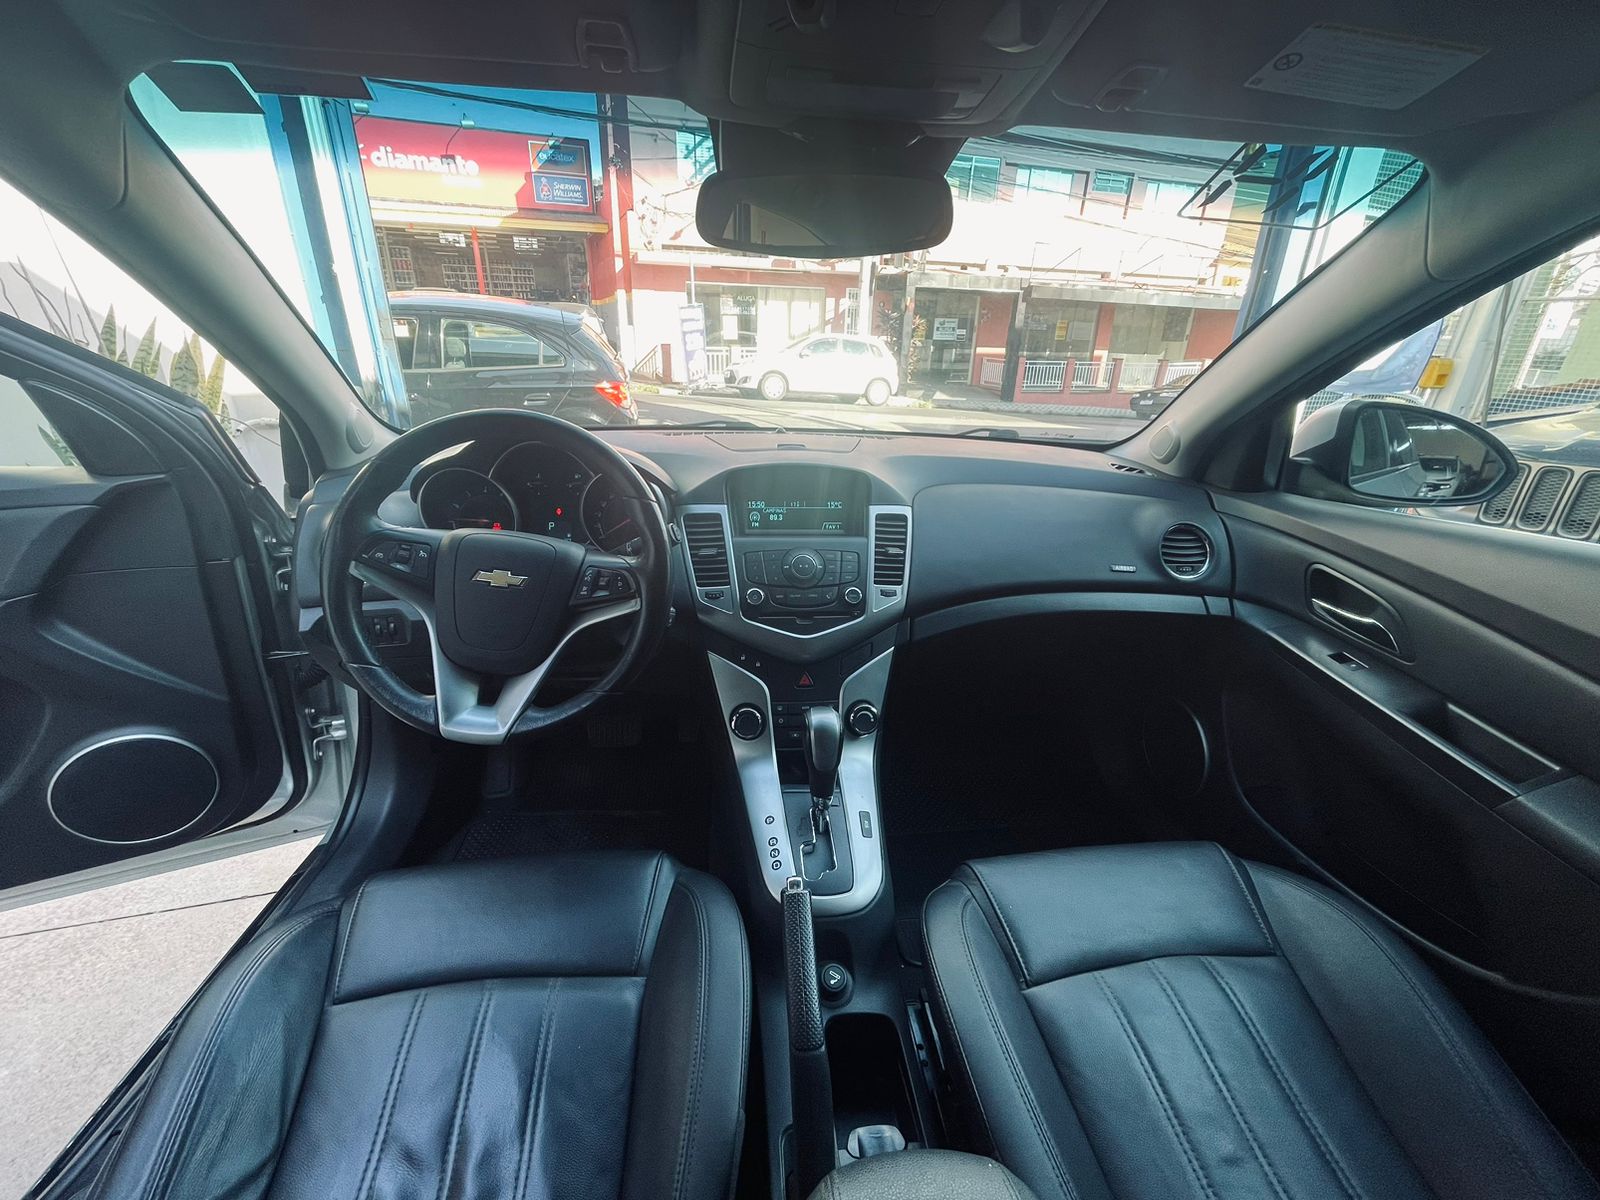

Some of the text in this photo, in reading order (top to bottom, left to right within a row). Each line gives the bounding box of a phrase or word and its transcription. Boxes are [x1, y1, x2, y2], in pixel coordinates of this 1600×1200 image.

[553, 181, 582, 191] SHERWIN
[769, 513, 783, 521] 89.3
[548, 521, 555, 531] P
